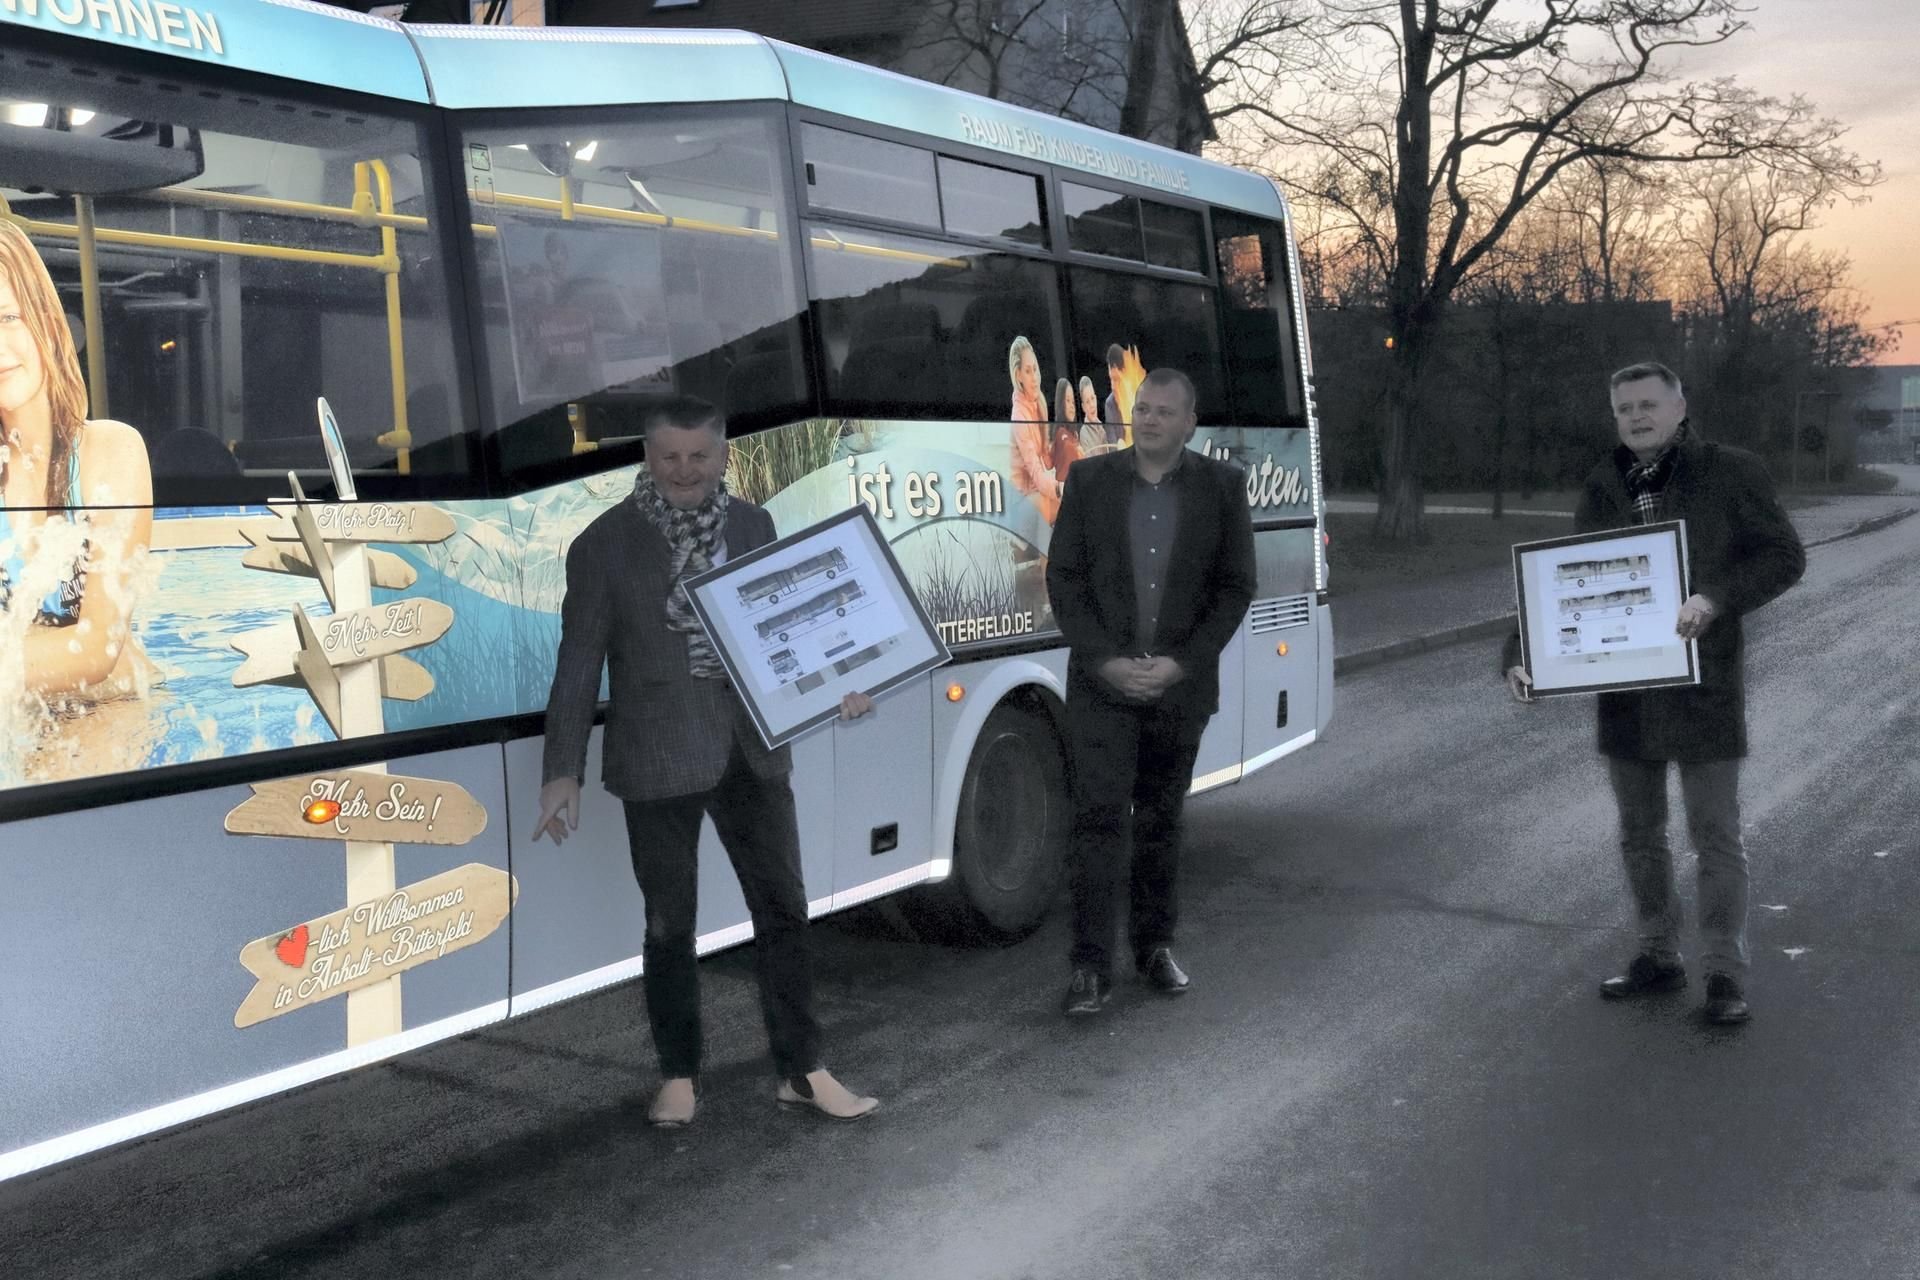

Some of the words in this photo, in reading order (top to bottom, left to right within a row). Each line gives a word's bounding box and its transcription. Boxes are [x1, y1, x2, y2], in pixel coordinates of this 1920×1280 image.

[959, 112, 1013, 147] RAUM
[1012, 122, 1049, 158] FÜR
[1049, 136, 1106, 170] KINDER
[1107, 151, 1138, 177] UND
[1140, 160, 1190, 191] FAMILIE
[847, 455, 893, 519] ist
[905, 471, 941, 517] es
[956, 470, 1002, 515] am
[317, 504, 365, 537] Mehr
[325, 617, 378, 657] Mehr
[300, 779, 370, 834] Mehr
[354, 887, 464, 937] Willkommen
[274, 984, 292, 1009] in
[298, 911, 474, 999] Anhalt-Bitterfeld
